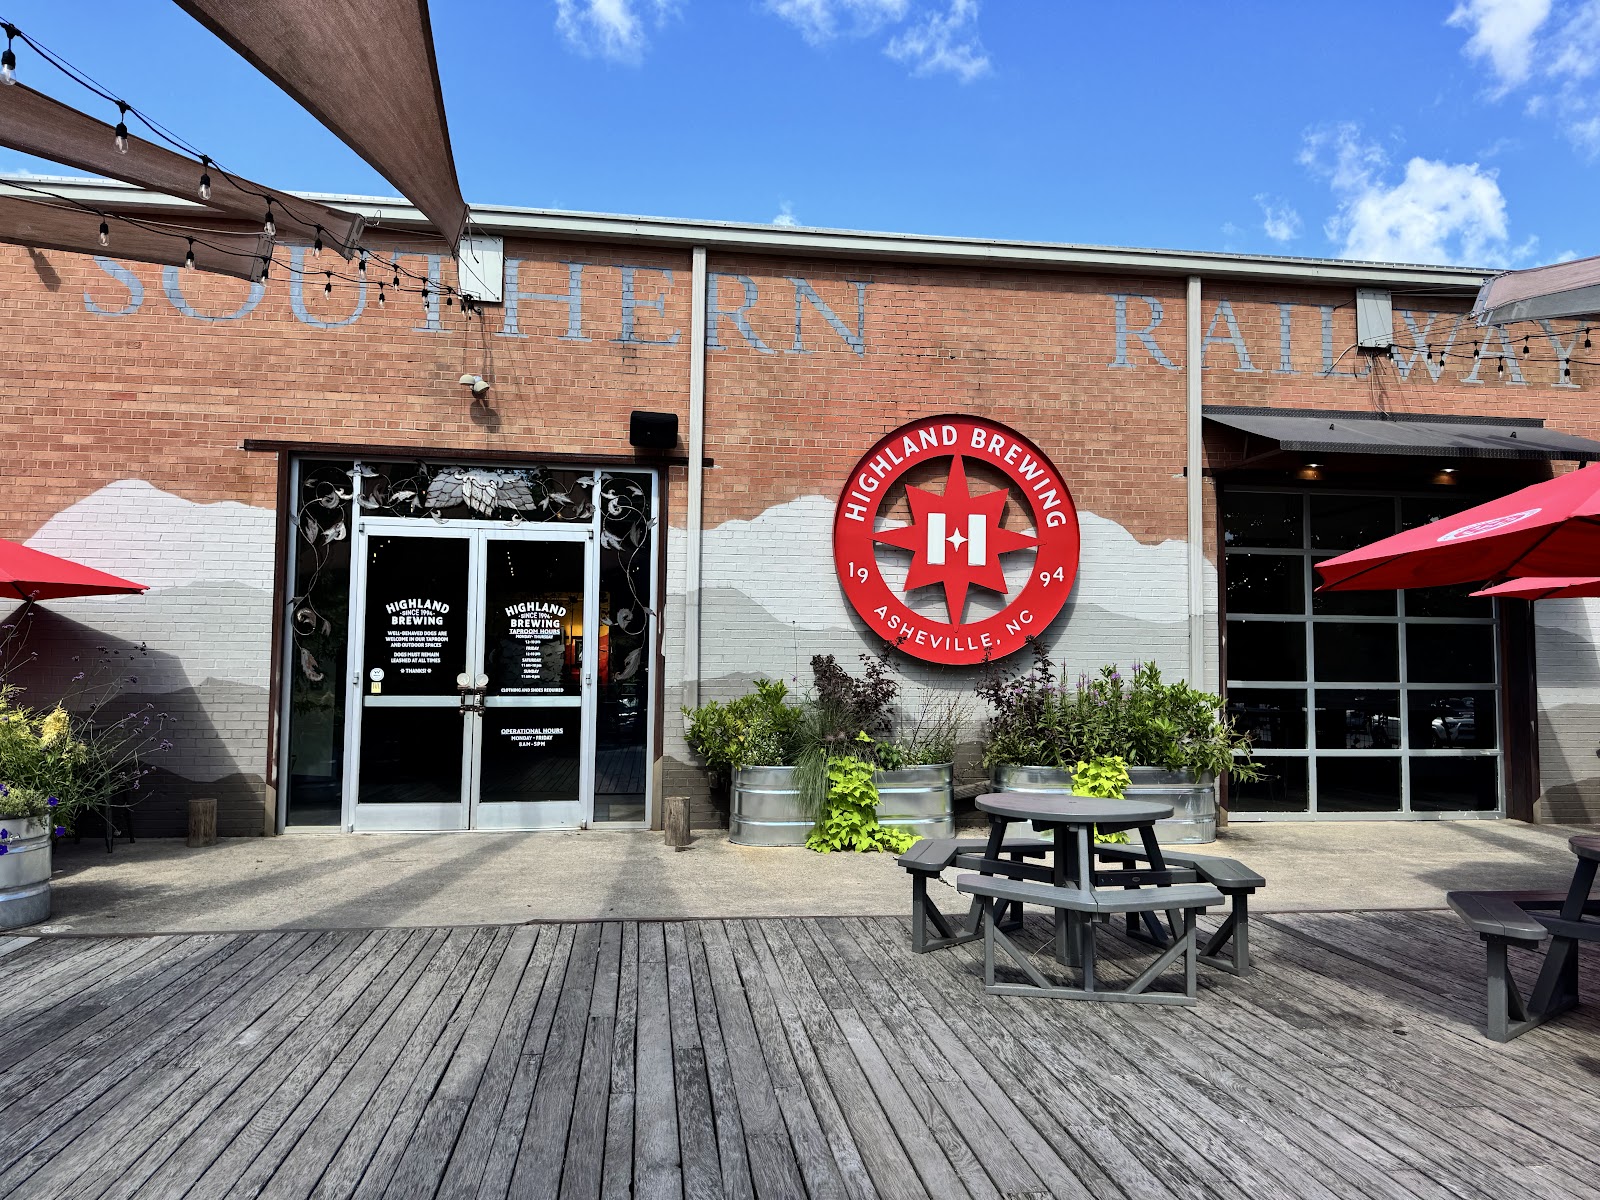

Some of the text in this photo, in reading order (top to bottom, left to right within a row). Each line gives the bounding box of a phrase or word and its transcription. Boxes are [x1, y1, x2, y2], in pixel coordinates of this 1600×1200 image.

[84, 241, 1587, 388] SOUTHERN RAILWAY
[844, 425, 1067, 528] HIGHLAND BREWING
[848, 562, 869, 584] 19
[1039, 567, 1065, 587] 94
[386, 598, 450, 614] HIGHLAND
[505, 601, 567, 617] HIGHLAND
[391, 615, 444, 626] BREWING
[510, 618, 560, 628] BREWING
[874, 605, 1034, 651] ASHEVILLE, NC
[542, 727, 564, 735] HOURS
